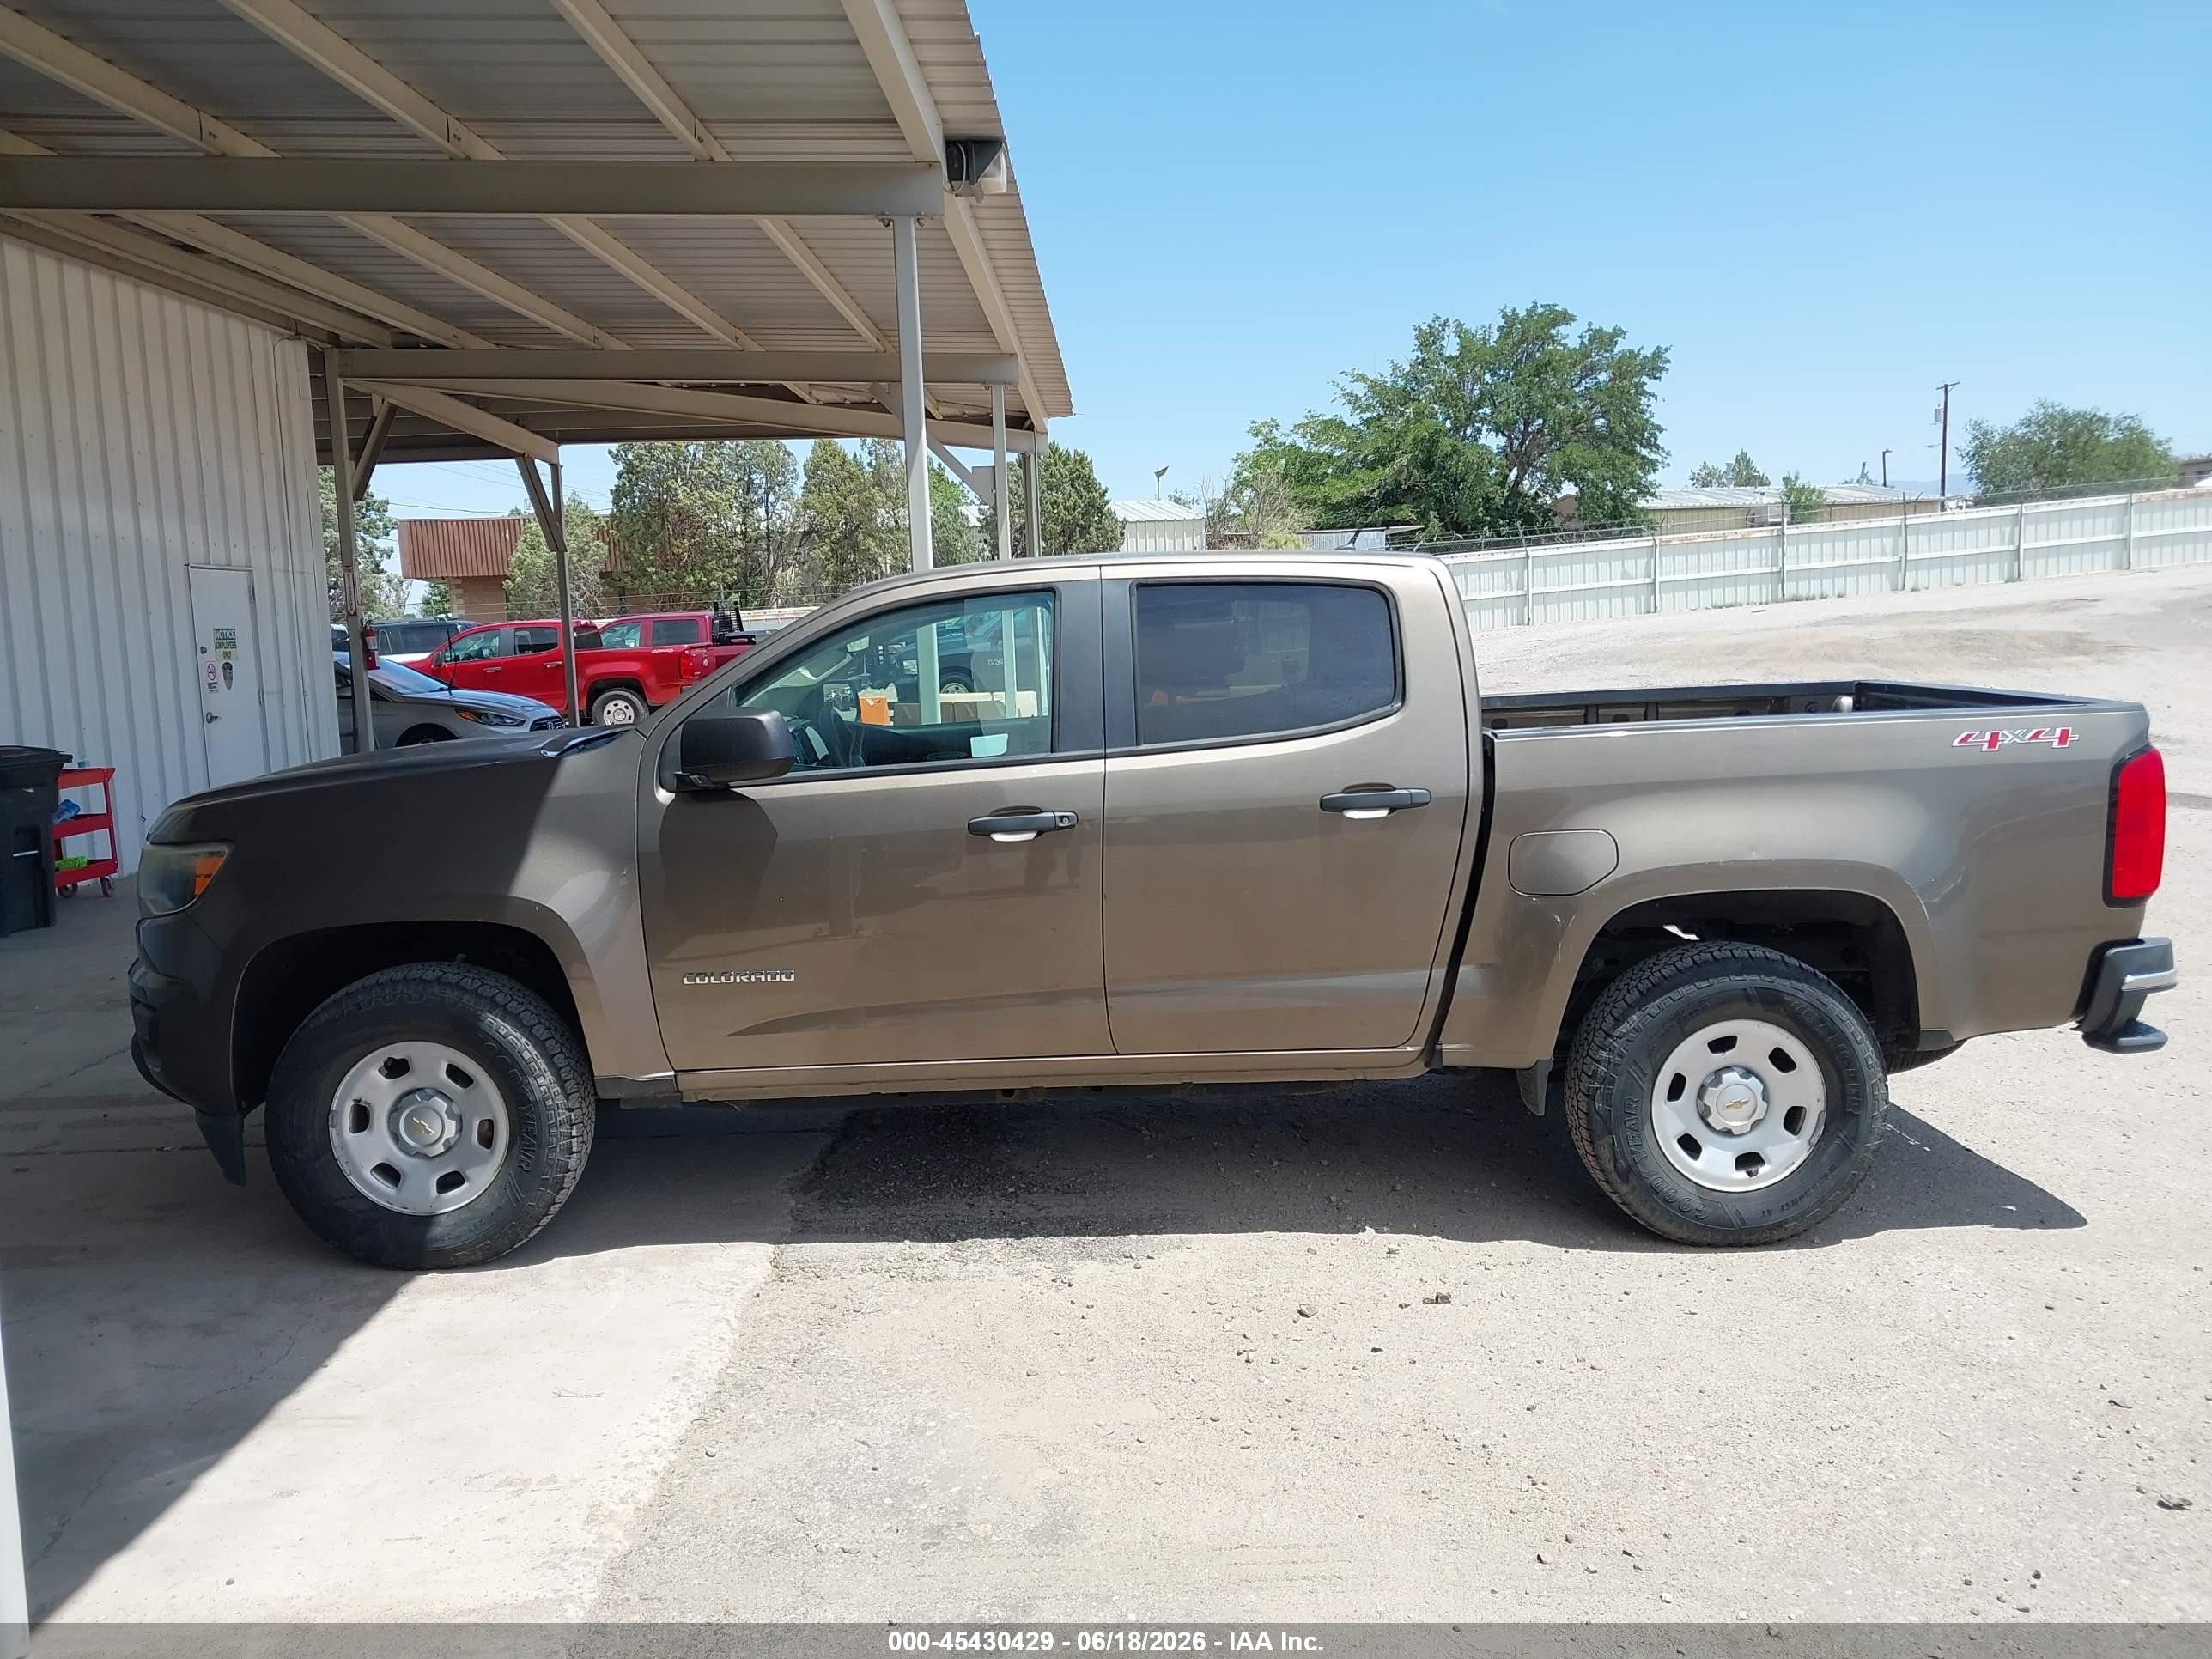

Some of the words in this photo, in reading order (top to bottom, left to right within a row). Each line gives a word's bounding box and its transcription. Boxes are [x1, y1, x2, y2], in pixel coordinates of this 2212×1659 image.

[215, 630, 236, 641] NOTICE
[216, 641, 237, 649] EMPLOYEES
[683, 970, 795, 985] COLORADO
